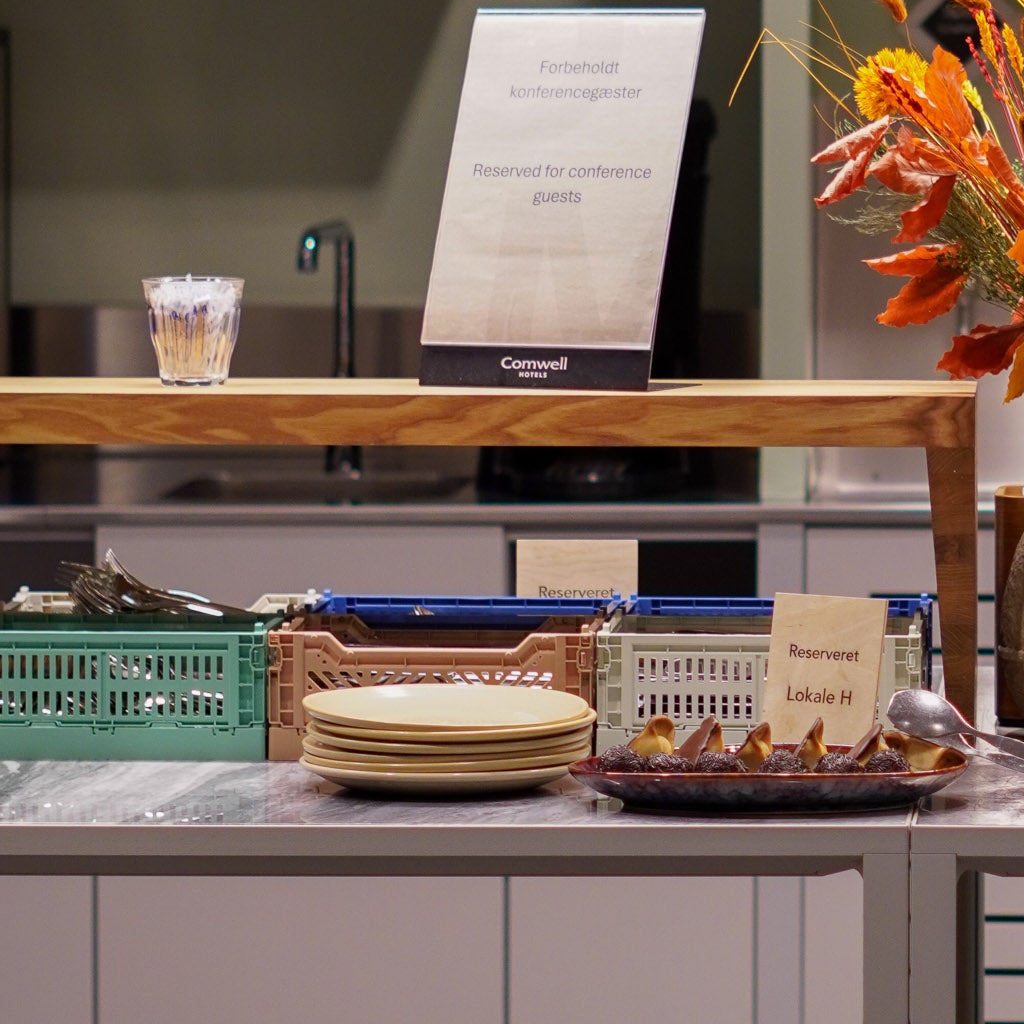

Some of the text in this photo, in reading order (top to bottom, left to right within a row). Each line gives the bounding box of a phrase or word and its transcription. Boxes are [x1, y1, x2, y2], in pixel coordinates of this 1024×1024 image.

[540, 60, 620, 74] Forbeholdt
[510, 85, 642, 102] konferencegæster
[473, 163, 652, 179] Reserved for conference
[532, 190, 582, 206] guests
[500, 356, 568, 371] Comwell
[518, 371, 548, 379] HOTELS
[538, 585, 615, 599] Reserveret
[789, 643, 860, 662] Reserveret
[787, 685, 853, 706] Lokale H
